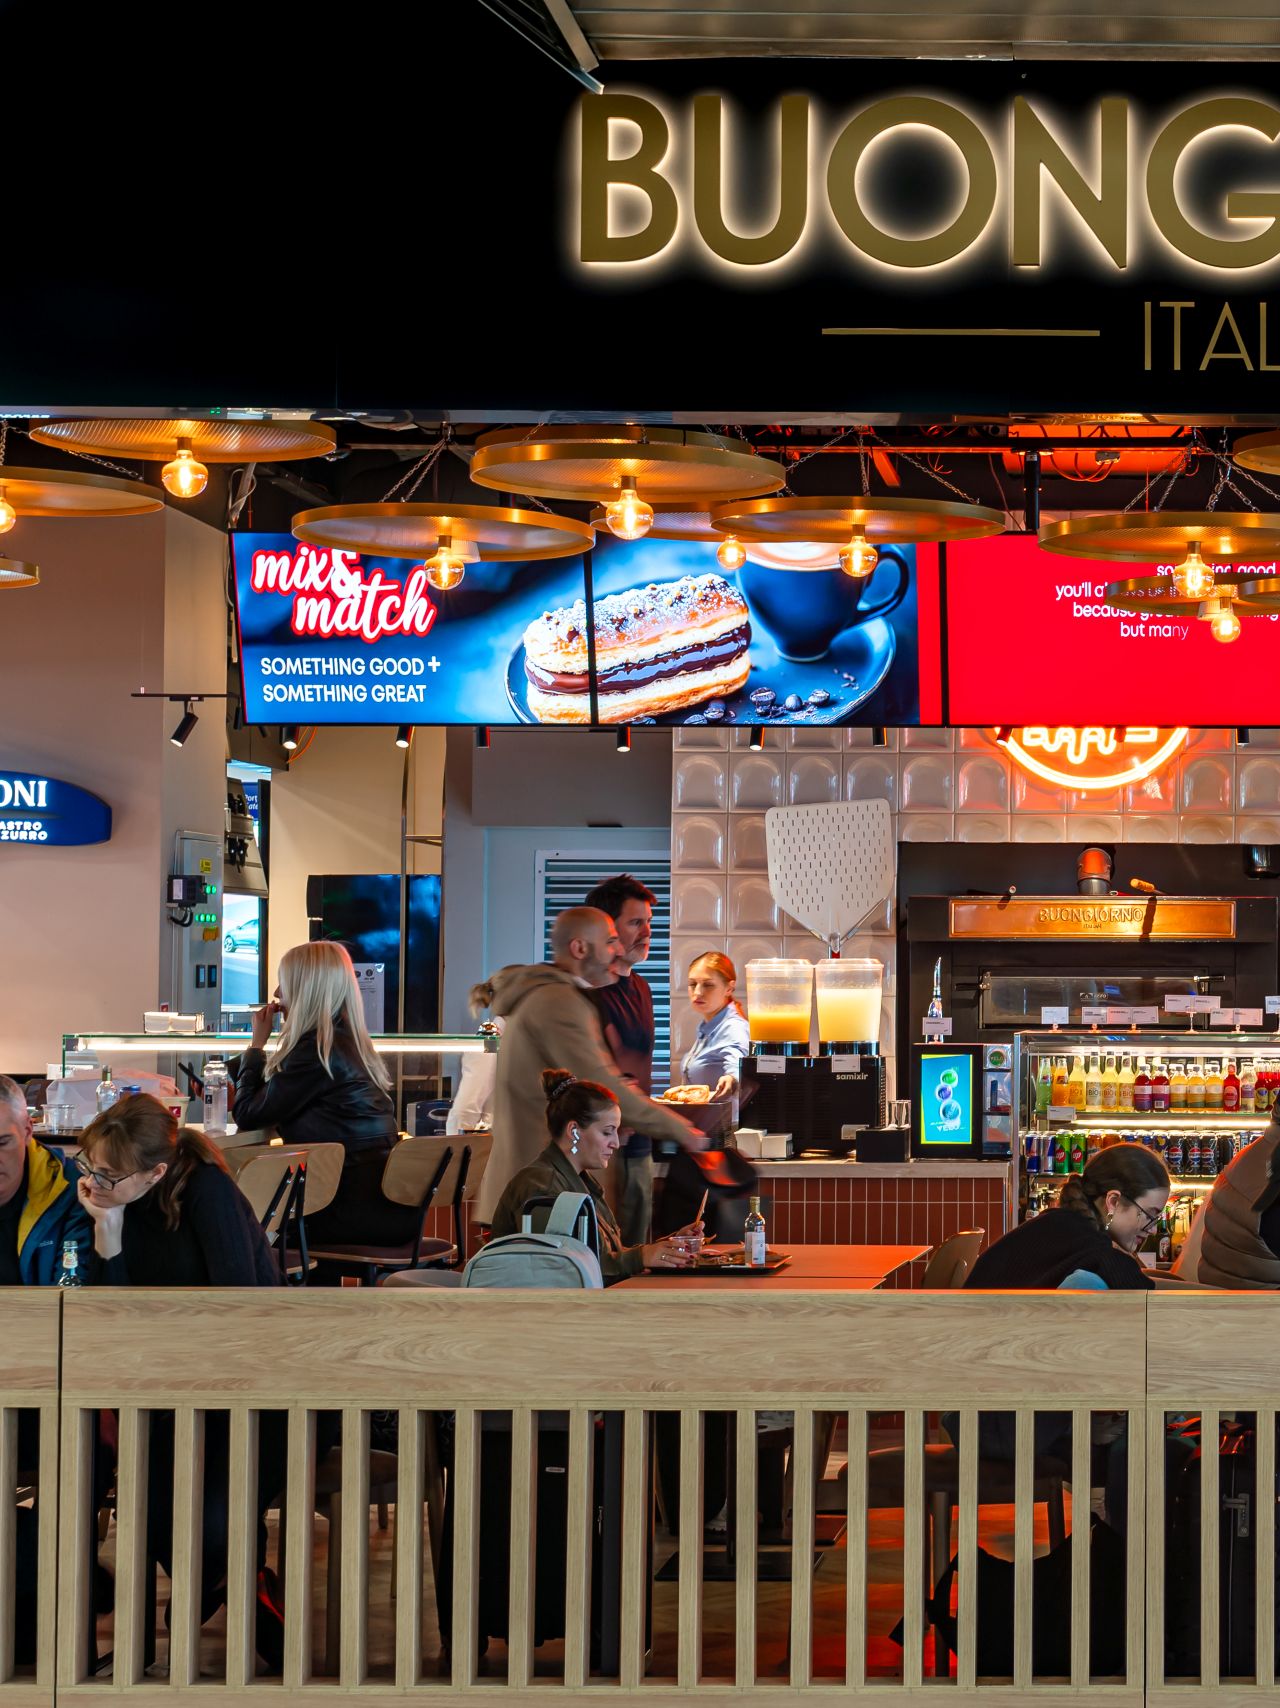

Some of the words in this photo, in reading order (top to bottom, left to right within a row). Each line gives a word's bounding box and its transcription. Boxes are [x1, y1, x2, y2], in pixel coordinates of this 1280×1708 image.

[1055, 581, 1092, 601] you'll
[295, 569, 435, 640] match
[1120, 621, 1145, 637] but
[1148, 625, 1189, 641] many
[260, 657, 366, 676] SOMETHING
[369, 657, 425, 676] GOOD
[262, 684, 368, 702] SOMETHING
[371, 684, 427, 702] GREAT
[1039, 907, 1144, 922] BUONGIORNO
